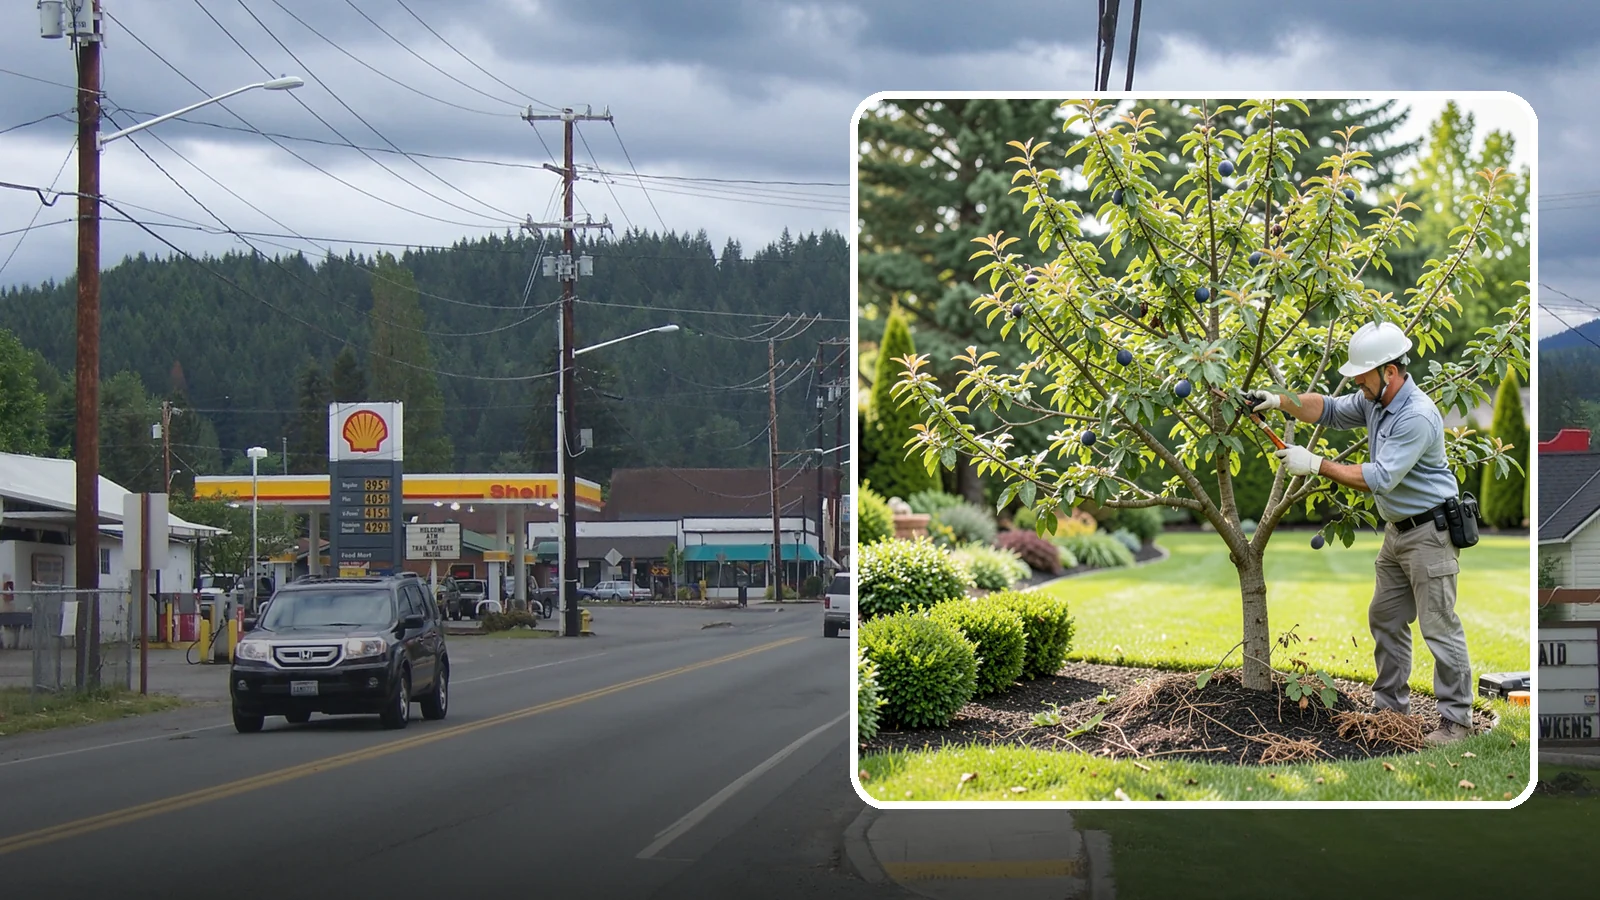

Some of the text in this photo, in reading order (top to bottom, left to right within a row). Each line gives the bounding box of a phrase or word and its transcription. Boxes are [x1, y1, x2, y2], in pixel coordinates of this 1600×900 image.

[366, 480, 384, 490] 395
[490, 484, 547, 499] Shell
[366, 494, 384, 504] 405
[366, 508, 384, 518] 415
[366, 522, 384, 532] 429
